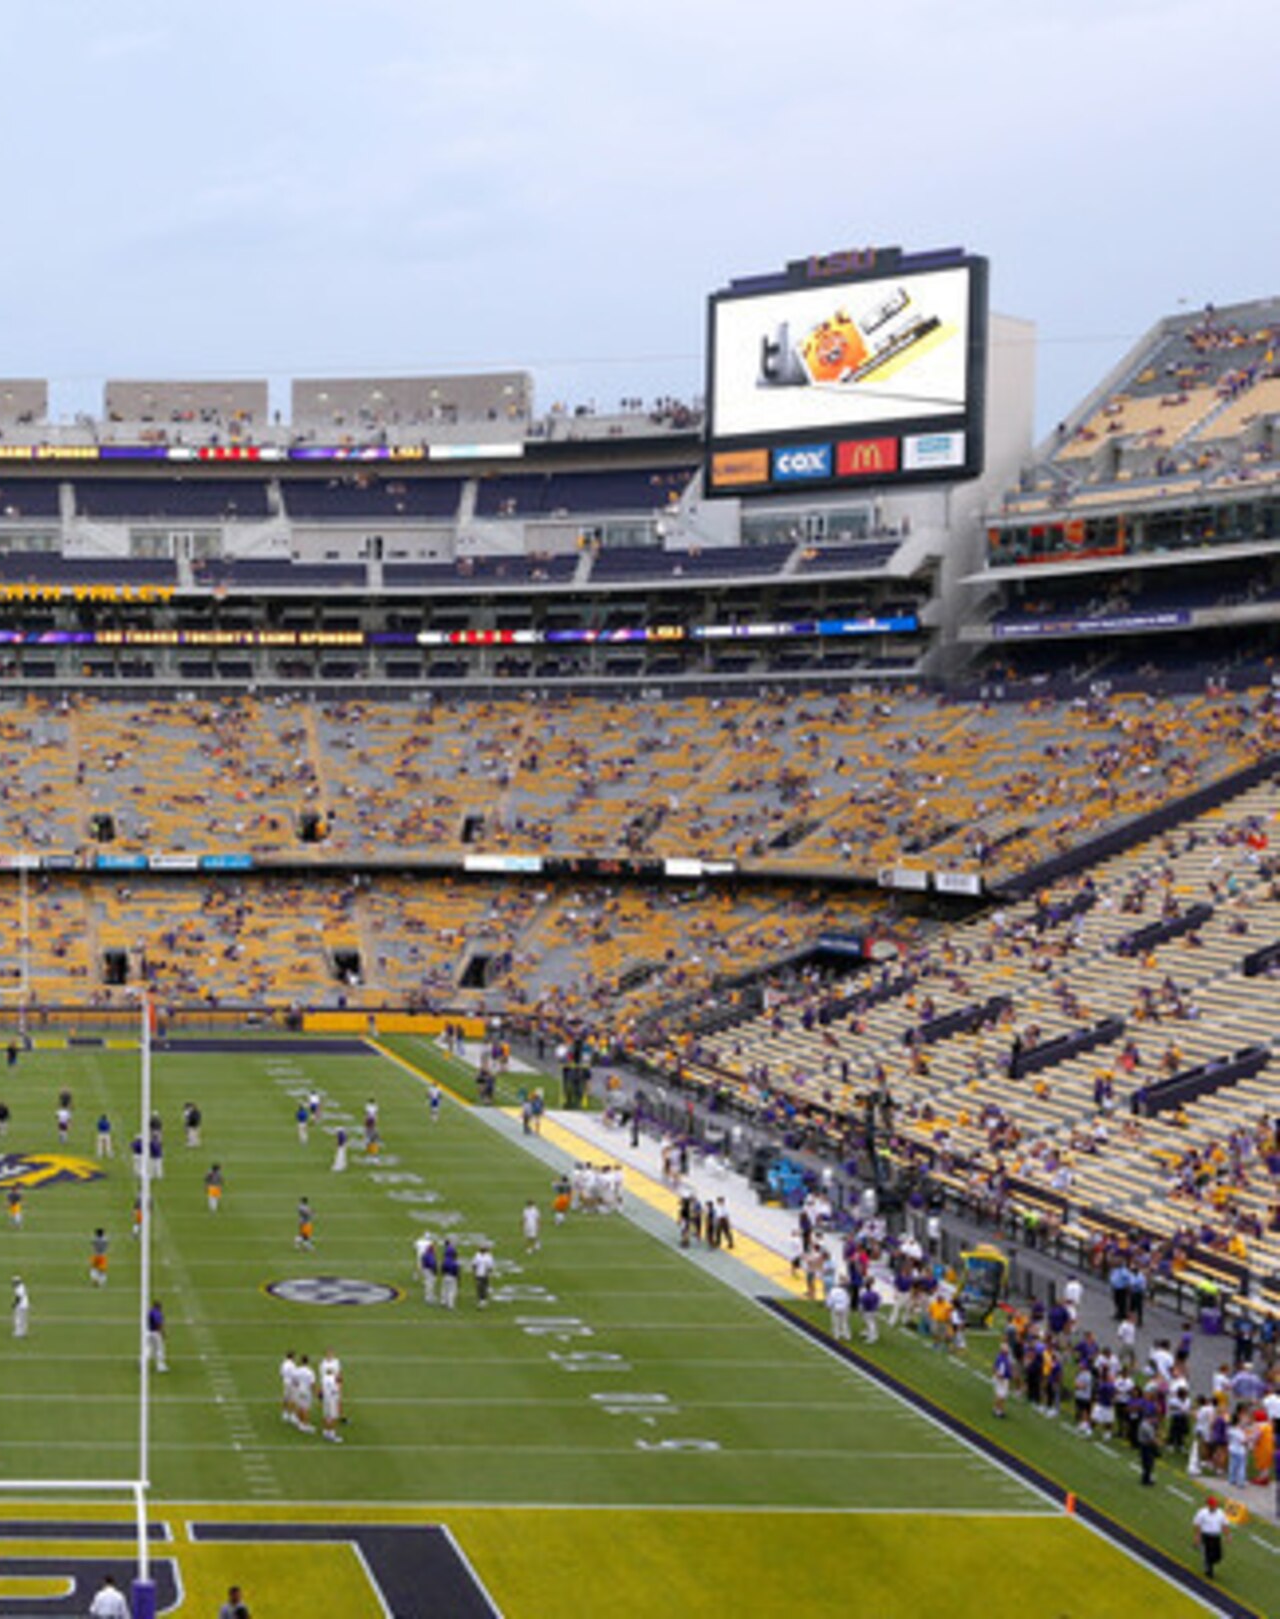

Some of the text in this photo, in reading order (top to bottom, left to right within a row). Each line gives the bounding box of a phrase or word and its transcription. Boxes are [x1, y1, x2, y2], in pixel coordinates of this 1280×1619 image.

[808, 248, 876, 278] LSU
[73, 583, 176, 603] VALLEY
[515, 1316, 595, 1336] 20
[549, 1351, 632, 1372] 15
[591, 1392, 680, 1414] 10
[636, 1438, 721, 1451] 5
